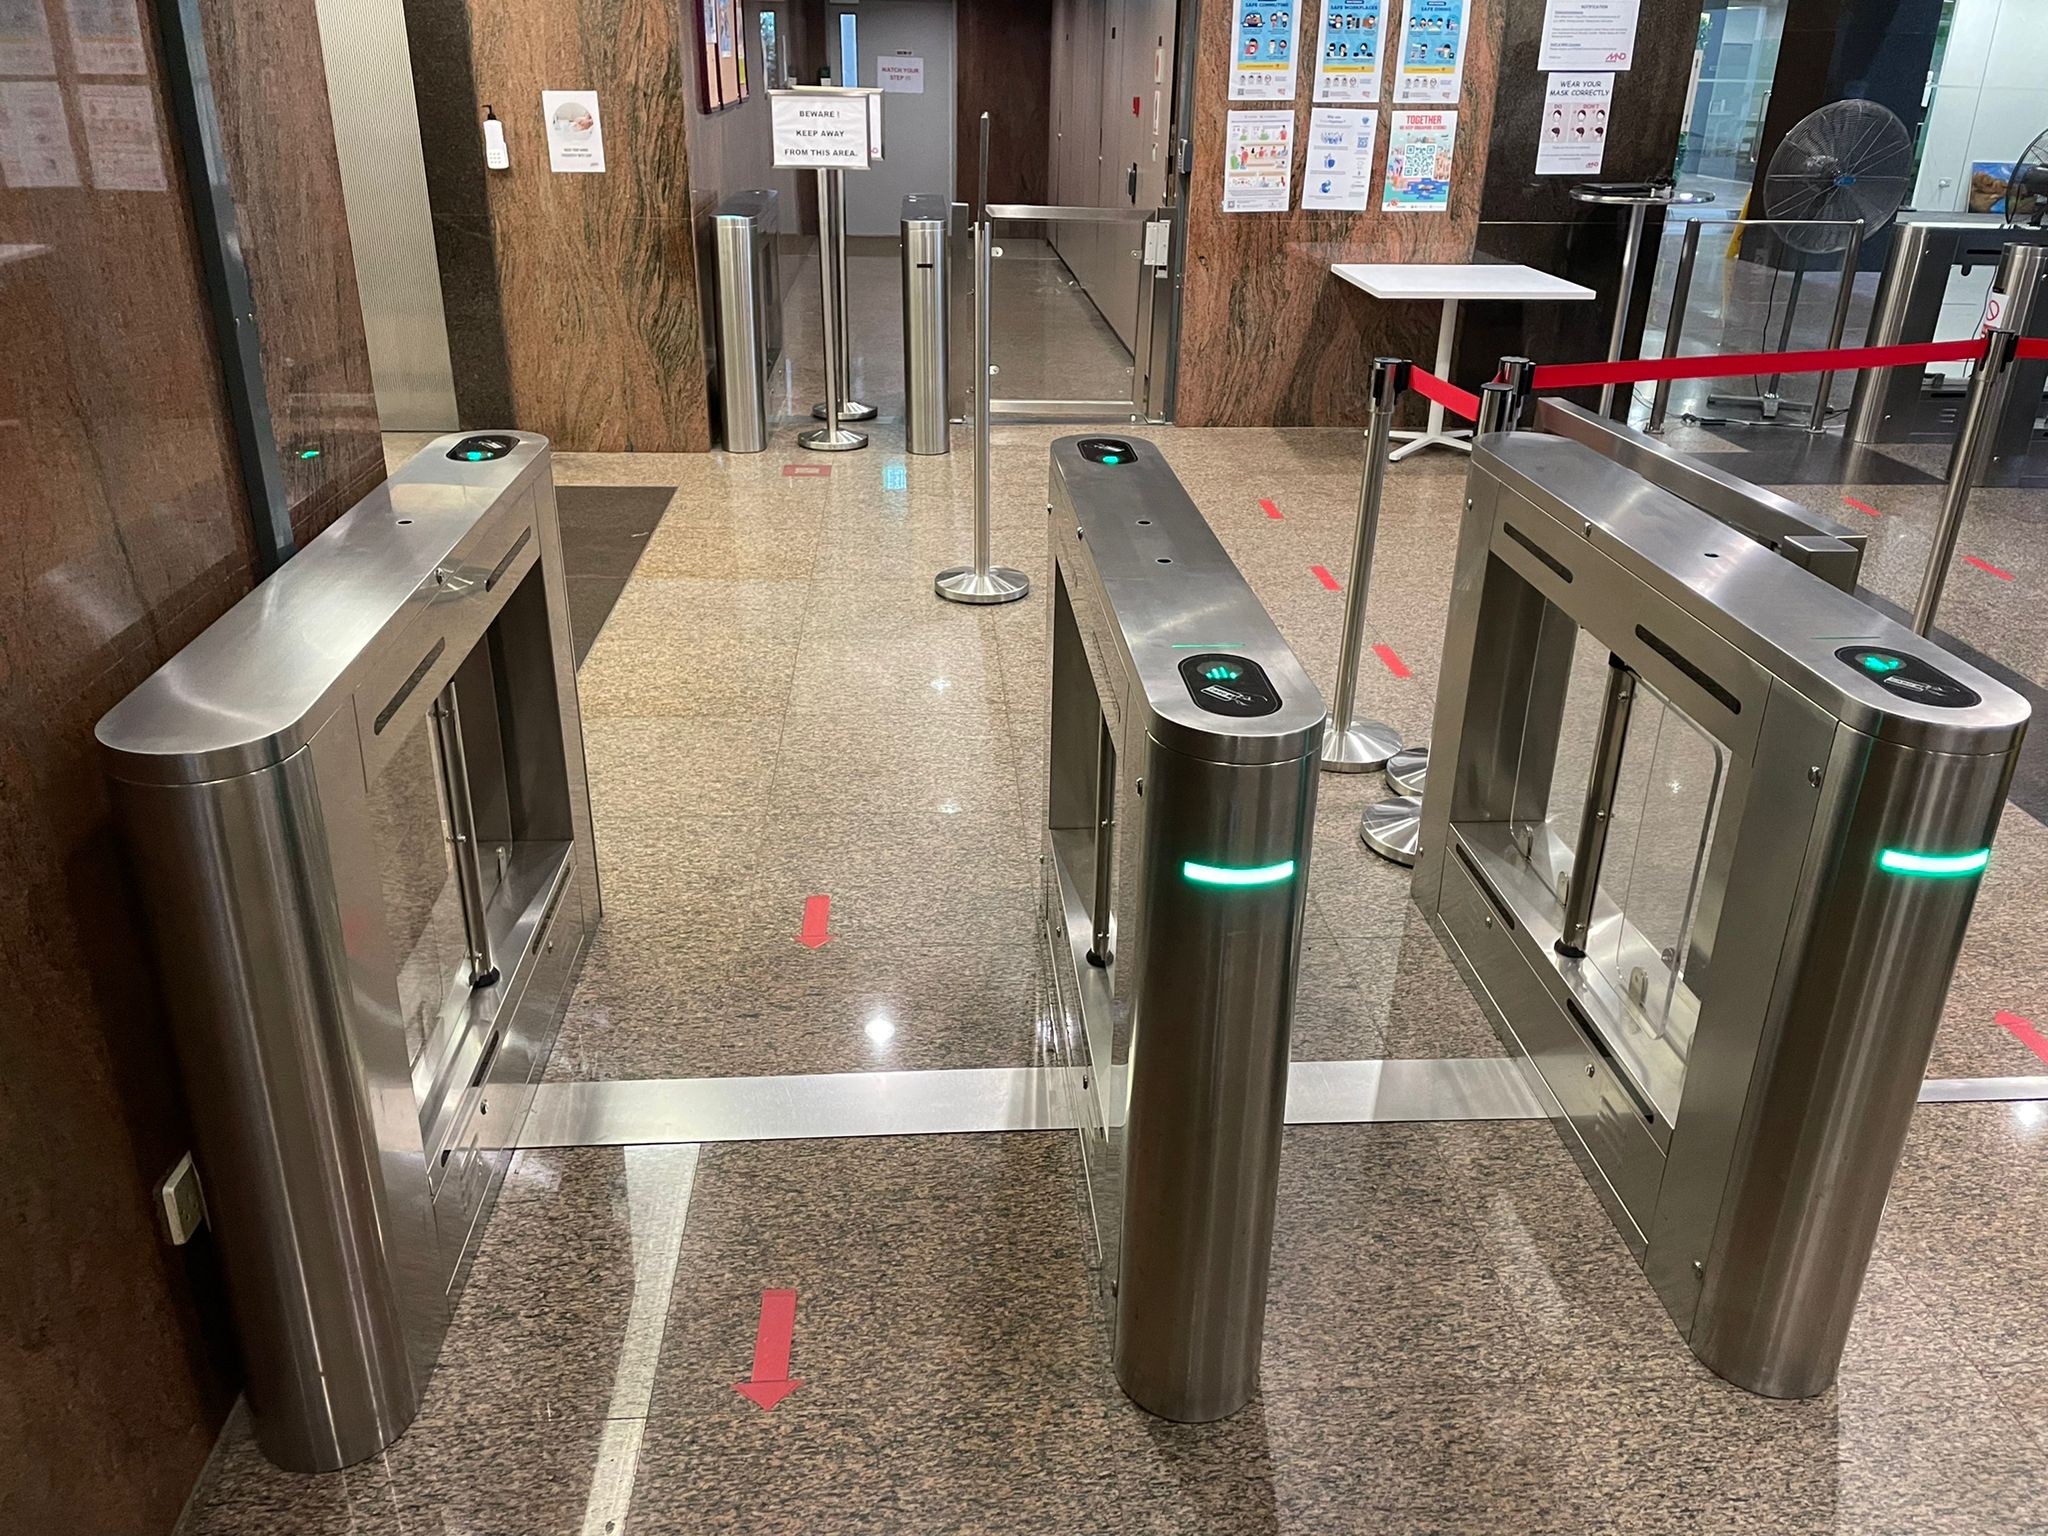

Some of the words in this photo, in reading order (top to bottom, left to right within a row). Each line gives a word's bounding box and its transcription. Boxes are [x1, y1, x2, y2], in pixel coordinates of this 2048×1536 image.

[1560, 80, 1580, 88] WEAR
[799, 110, 835, 118] BEWARE
[1406, 114, 1442, 125] TOGETHER
[796, 129, 819, 137] KEEP
[784, 148, 809, 156] FROM
[832, 149, 858, 157] AREA.
